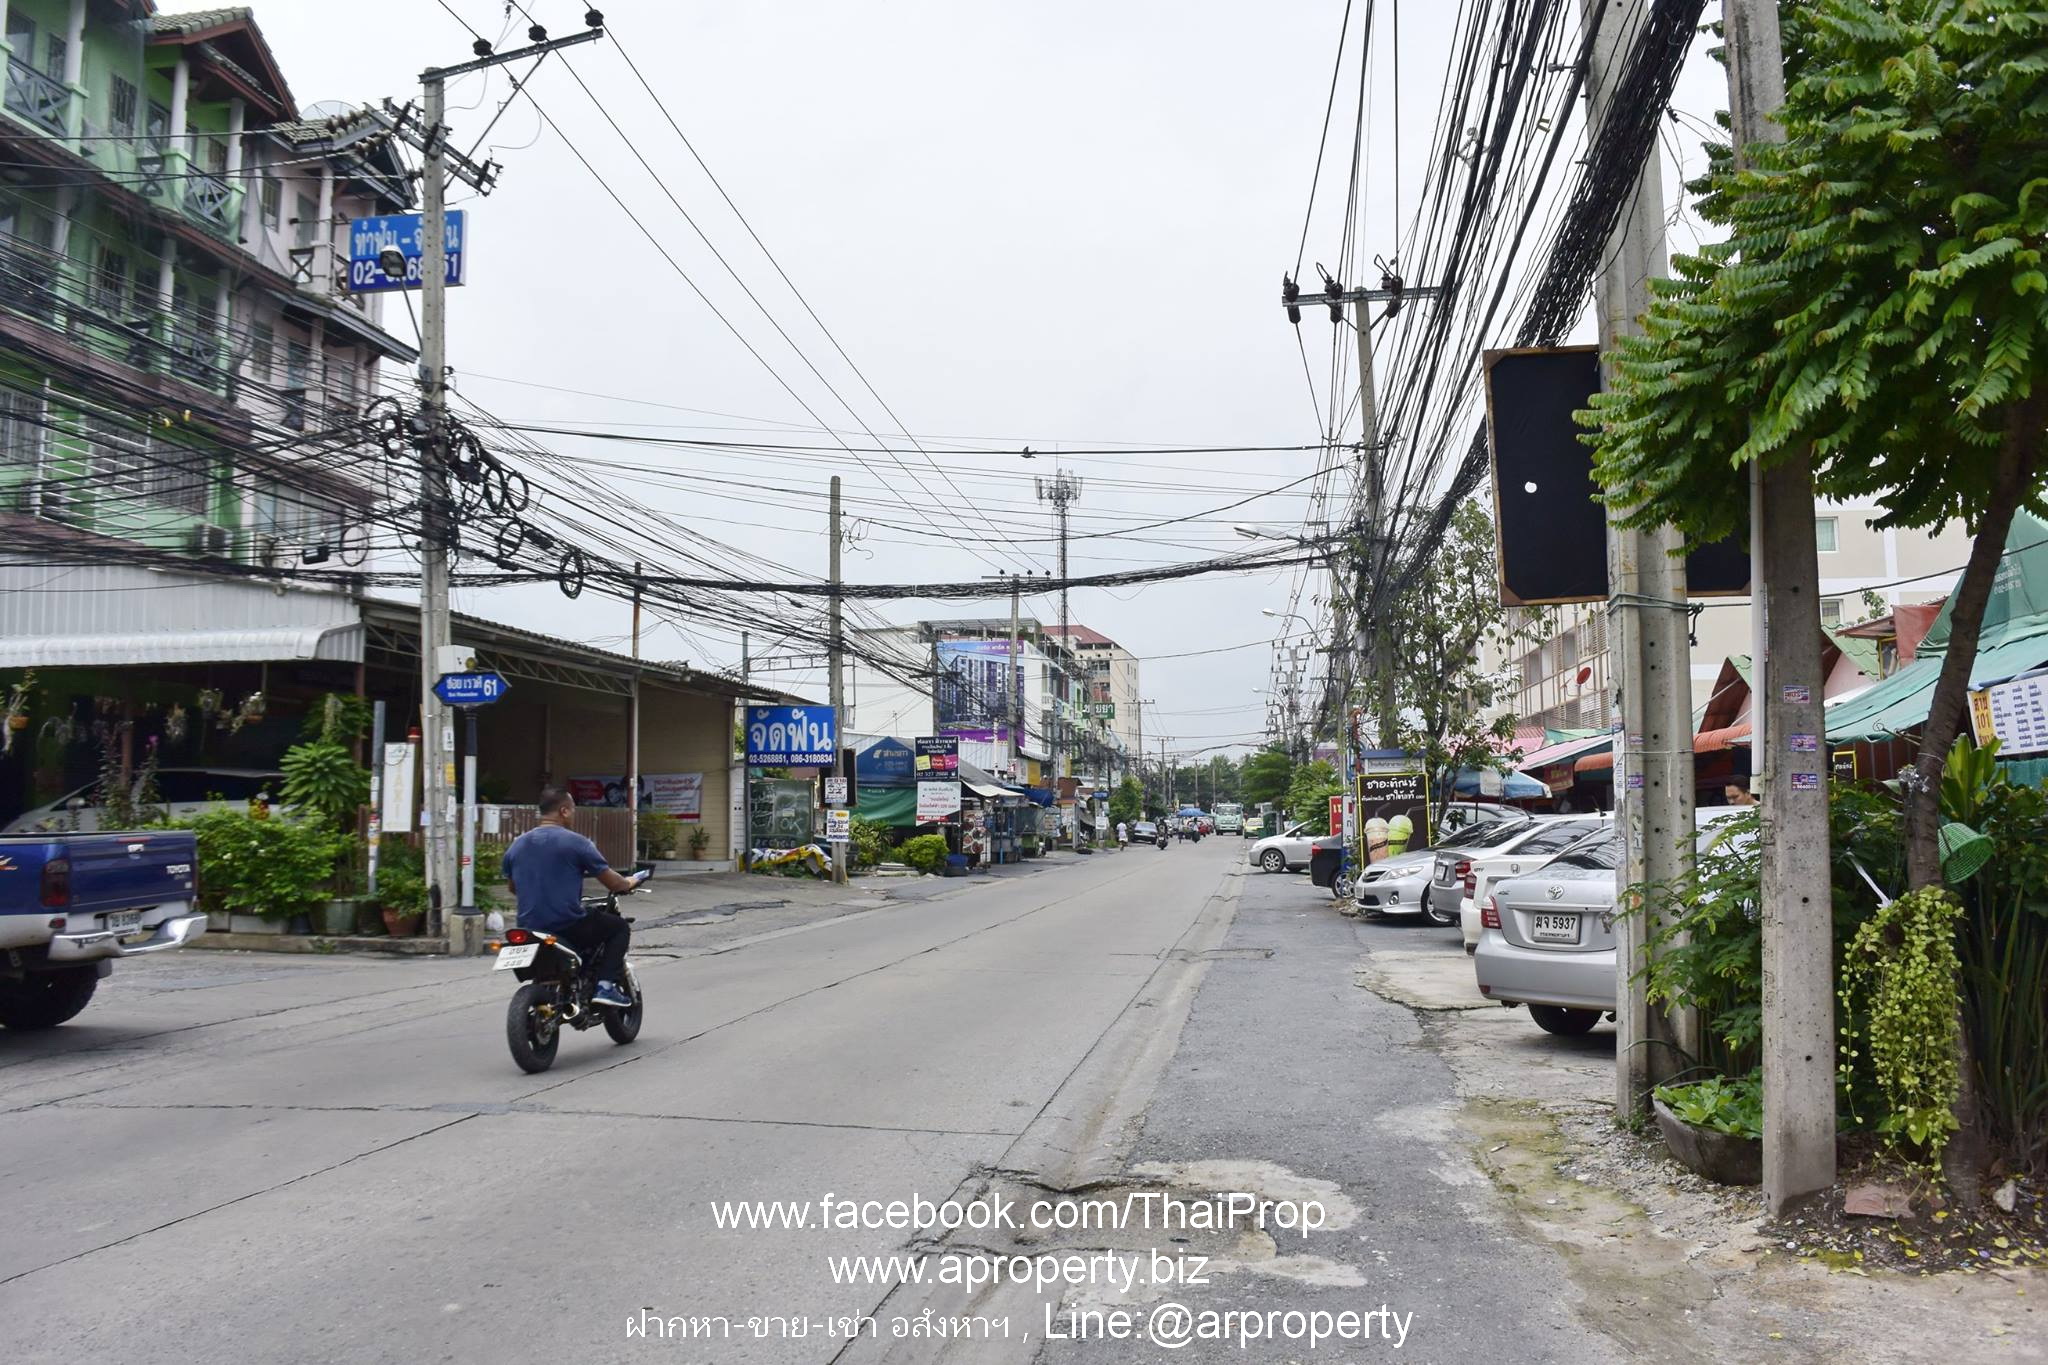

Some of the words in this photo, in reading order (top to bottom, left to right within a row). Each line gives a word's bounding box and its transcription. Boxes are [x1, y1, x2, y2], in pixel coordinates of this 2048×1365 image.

[446, 676, 462, 689] ซอย
[484, 679, 497, 696] 61
[750, 708, 832, 752] จัดฟัน
[1552, 917, 1576, 930] 5937
